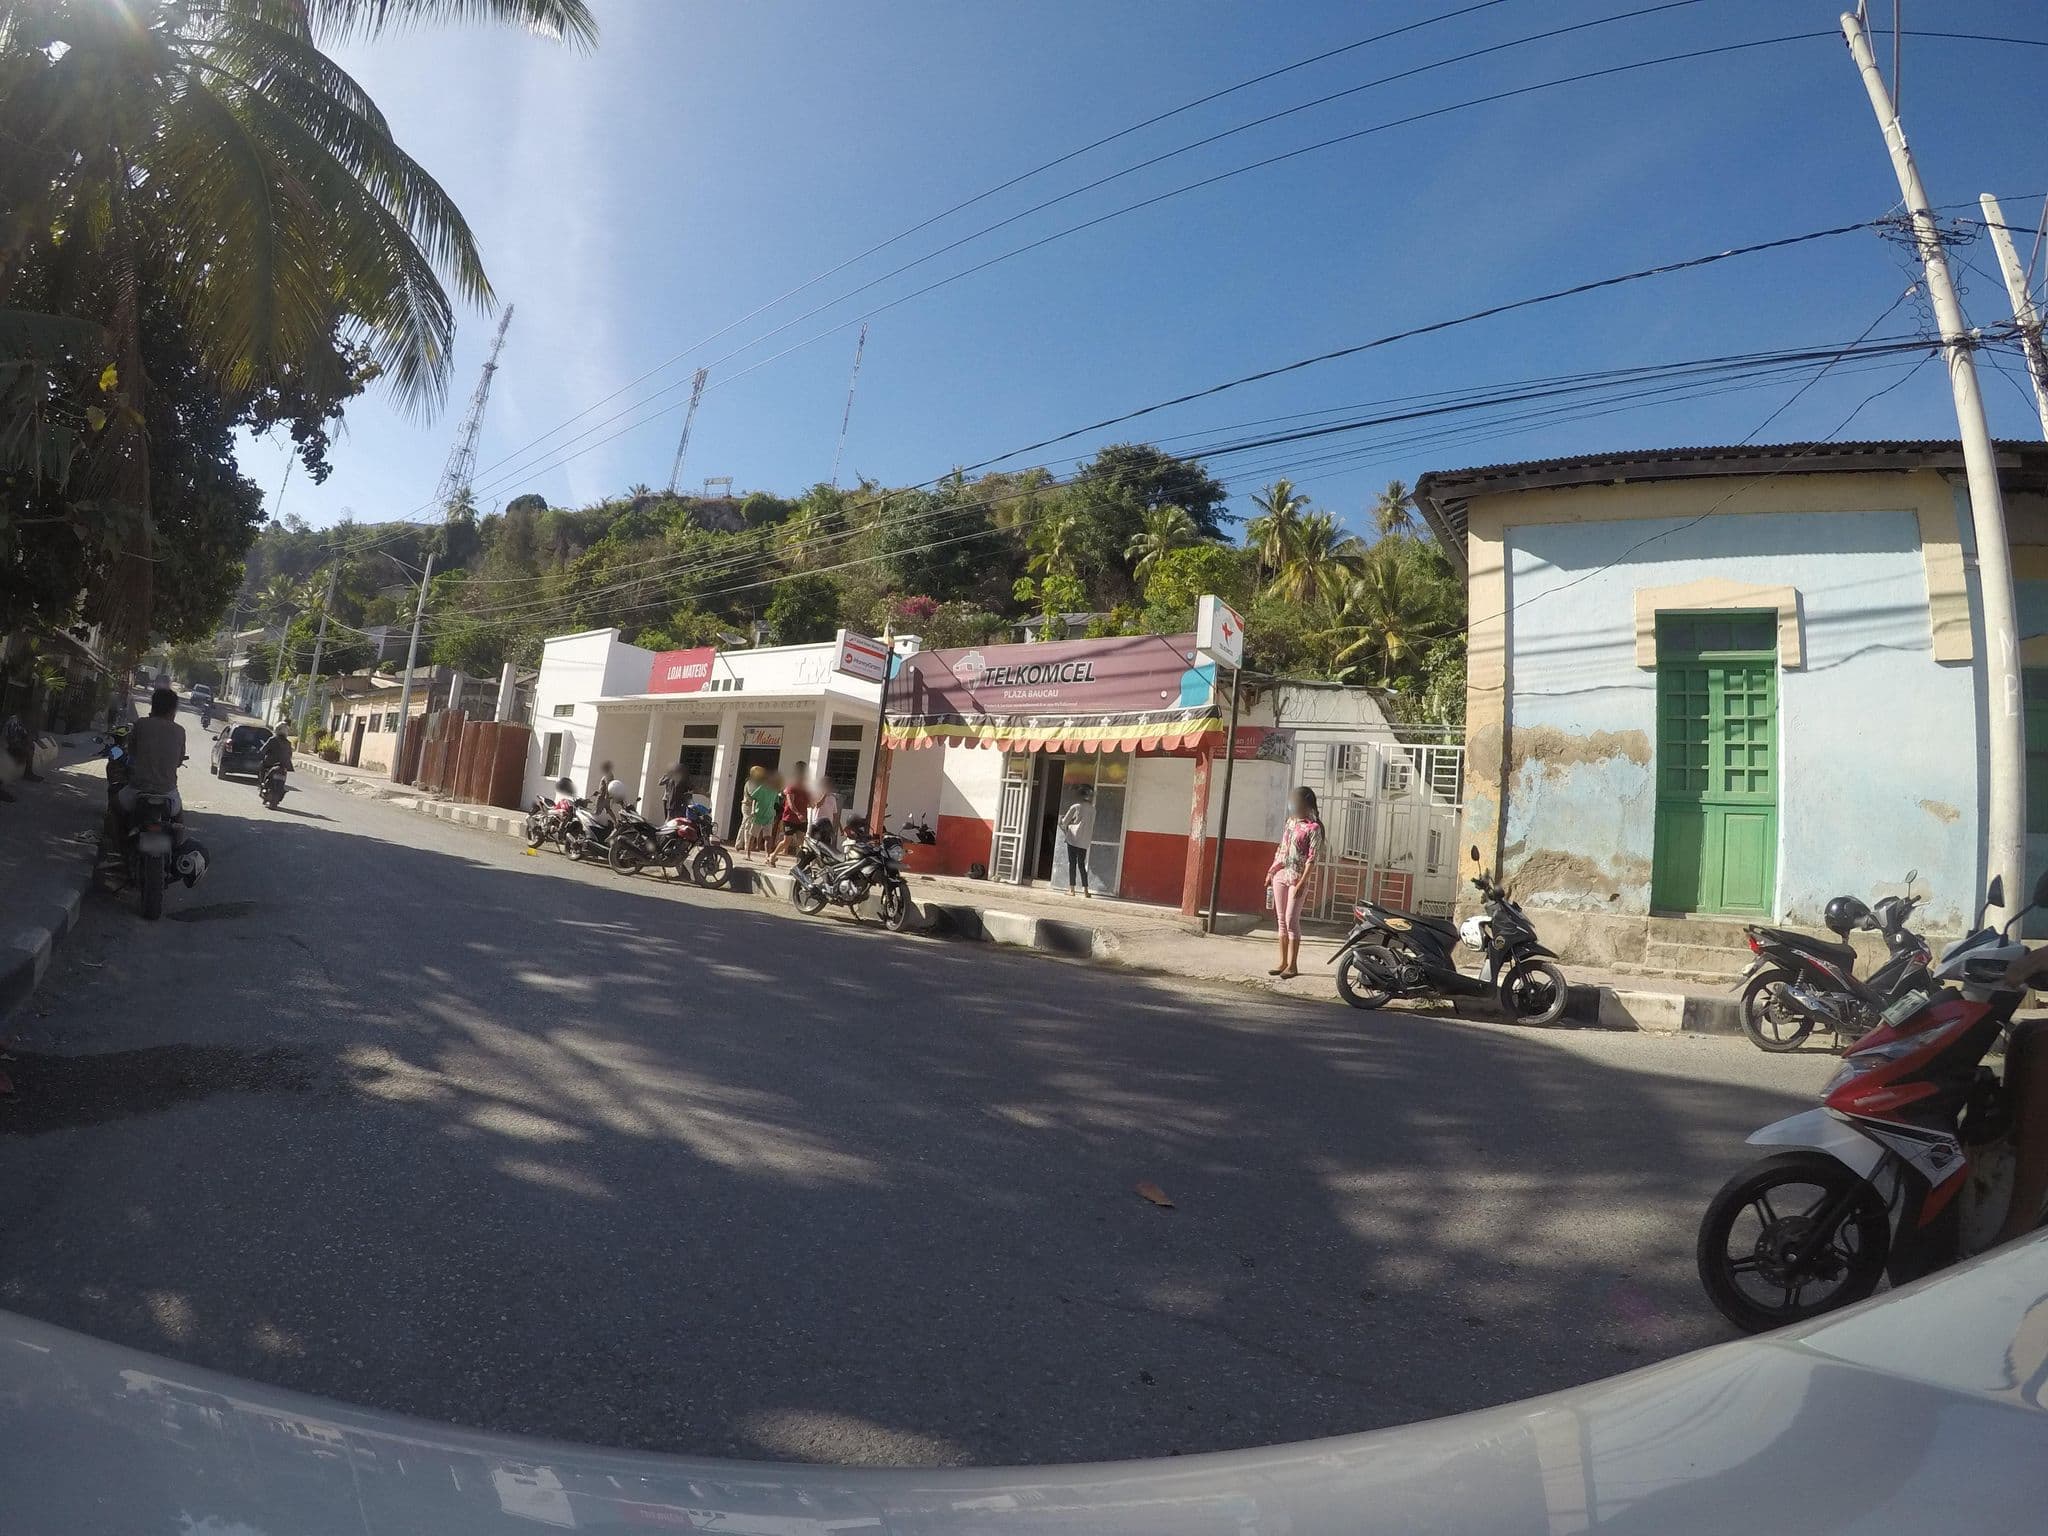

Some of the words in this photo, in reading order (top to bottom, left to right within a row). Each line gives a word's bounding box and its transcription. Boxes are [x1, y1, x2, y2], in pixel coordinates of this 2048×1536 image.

[667, 665, 682, 680] LOJA
[682, 663, 708, 679] MATEUS
[984, 660, 1095, 686] TELKOMCEL
[1003, 690, 1027, 699] PLAZA
[1028, 688, 1060, 698] BAUCAU
